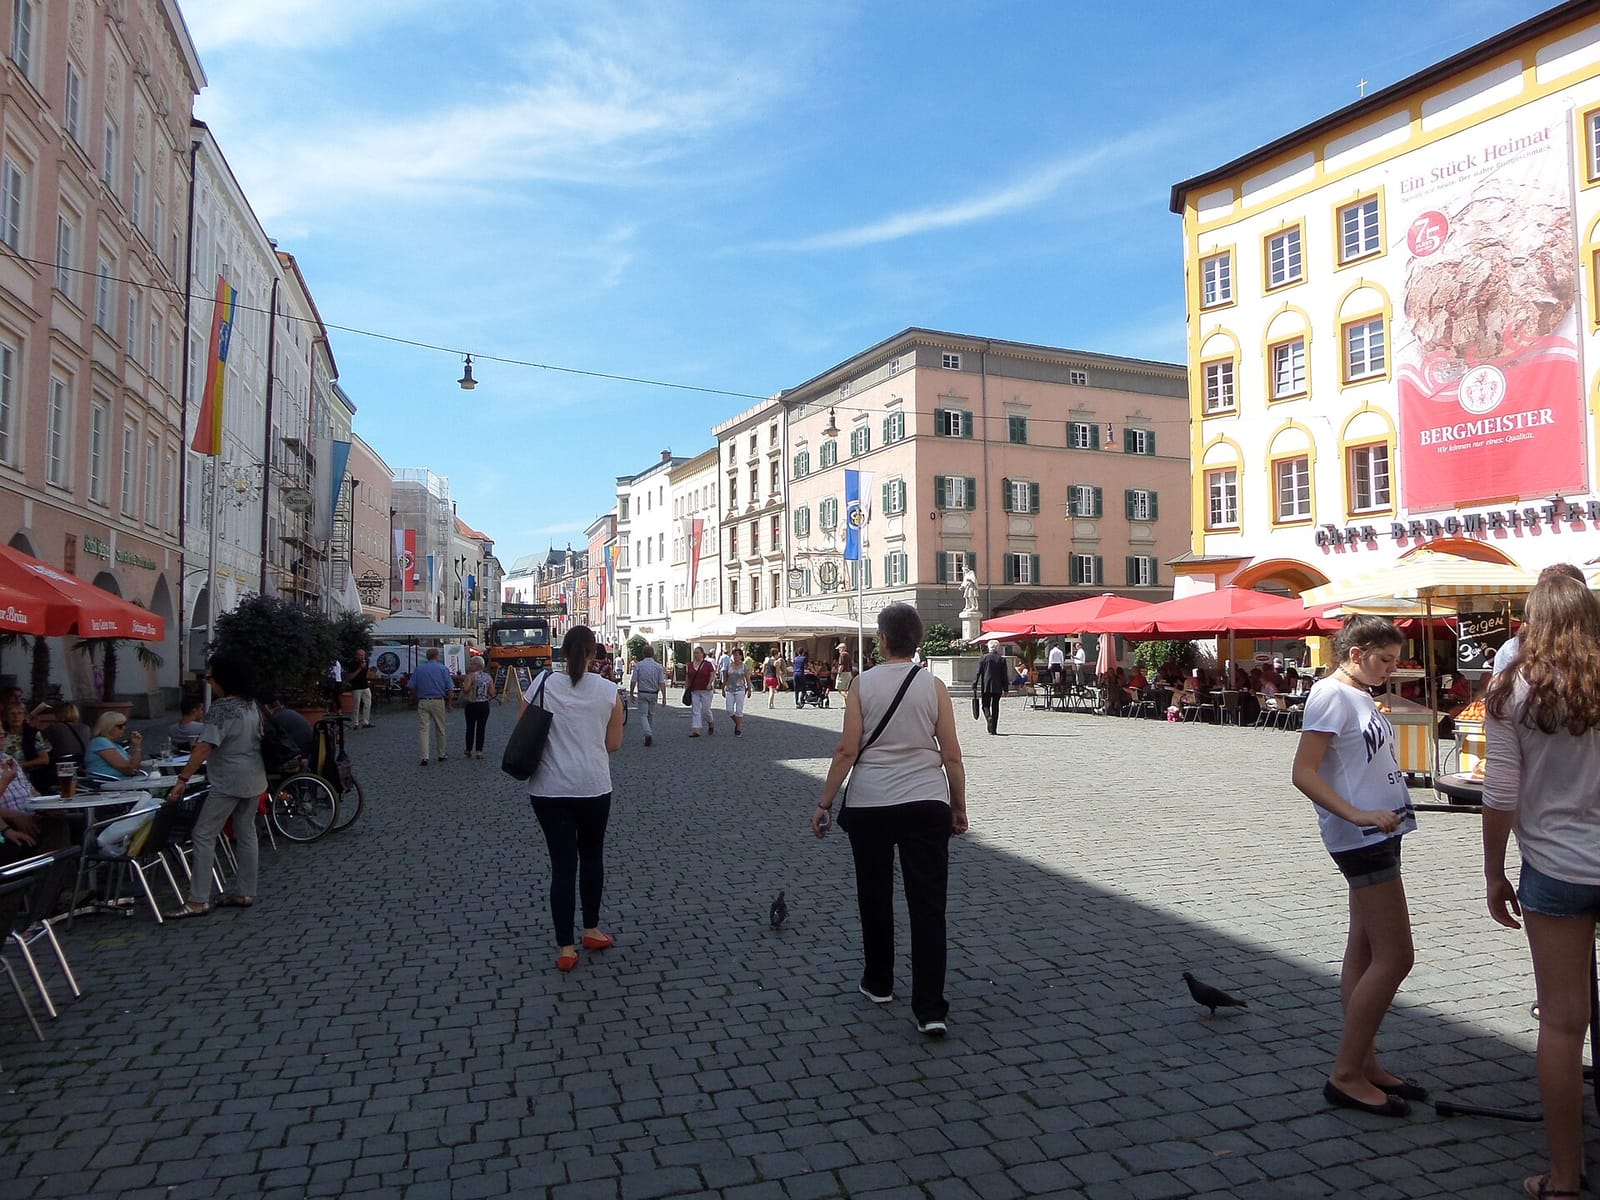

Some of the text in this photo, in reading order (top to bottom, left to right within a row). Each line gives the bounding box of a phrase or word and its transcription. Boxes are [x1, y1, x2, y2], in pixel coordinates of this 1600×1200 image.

[1400, 127, 1551, 194] Ein Stück Heimat
[1458, 174, 1471, 183] Der
[1413, 217, 1441, 251] 75
[1420, 408, 1555, 446] BERGMEISTER
[1437, 446, 1448, 454] Wir
[1448, 442, 1472, 452] können
[1472, 440, 1484, 448] nur
[1391, 501, 1600, 540] BERGMEISTER
[6, 606, 28, 624] Bräu
[1459, 617, 1504, 637] Feigen
[1459, 643, 1473, 662] 3
